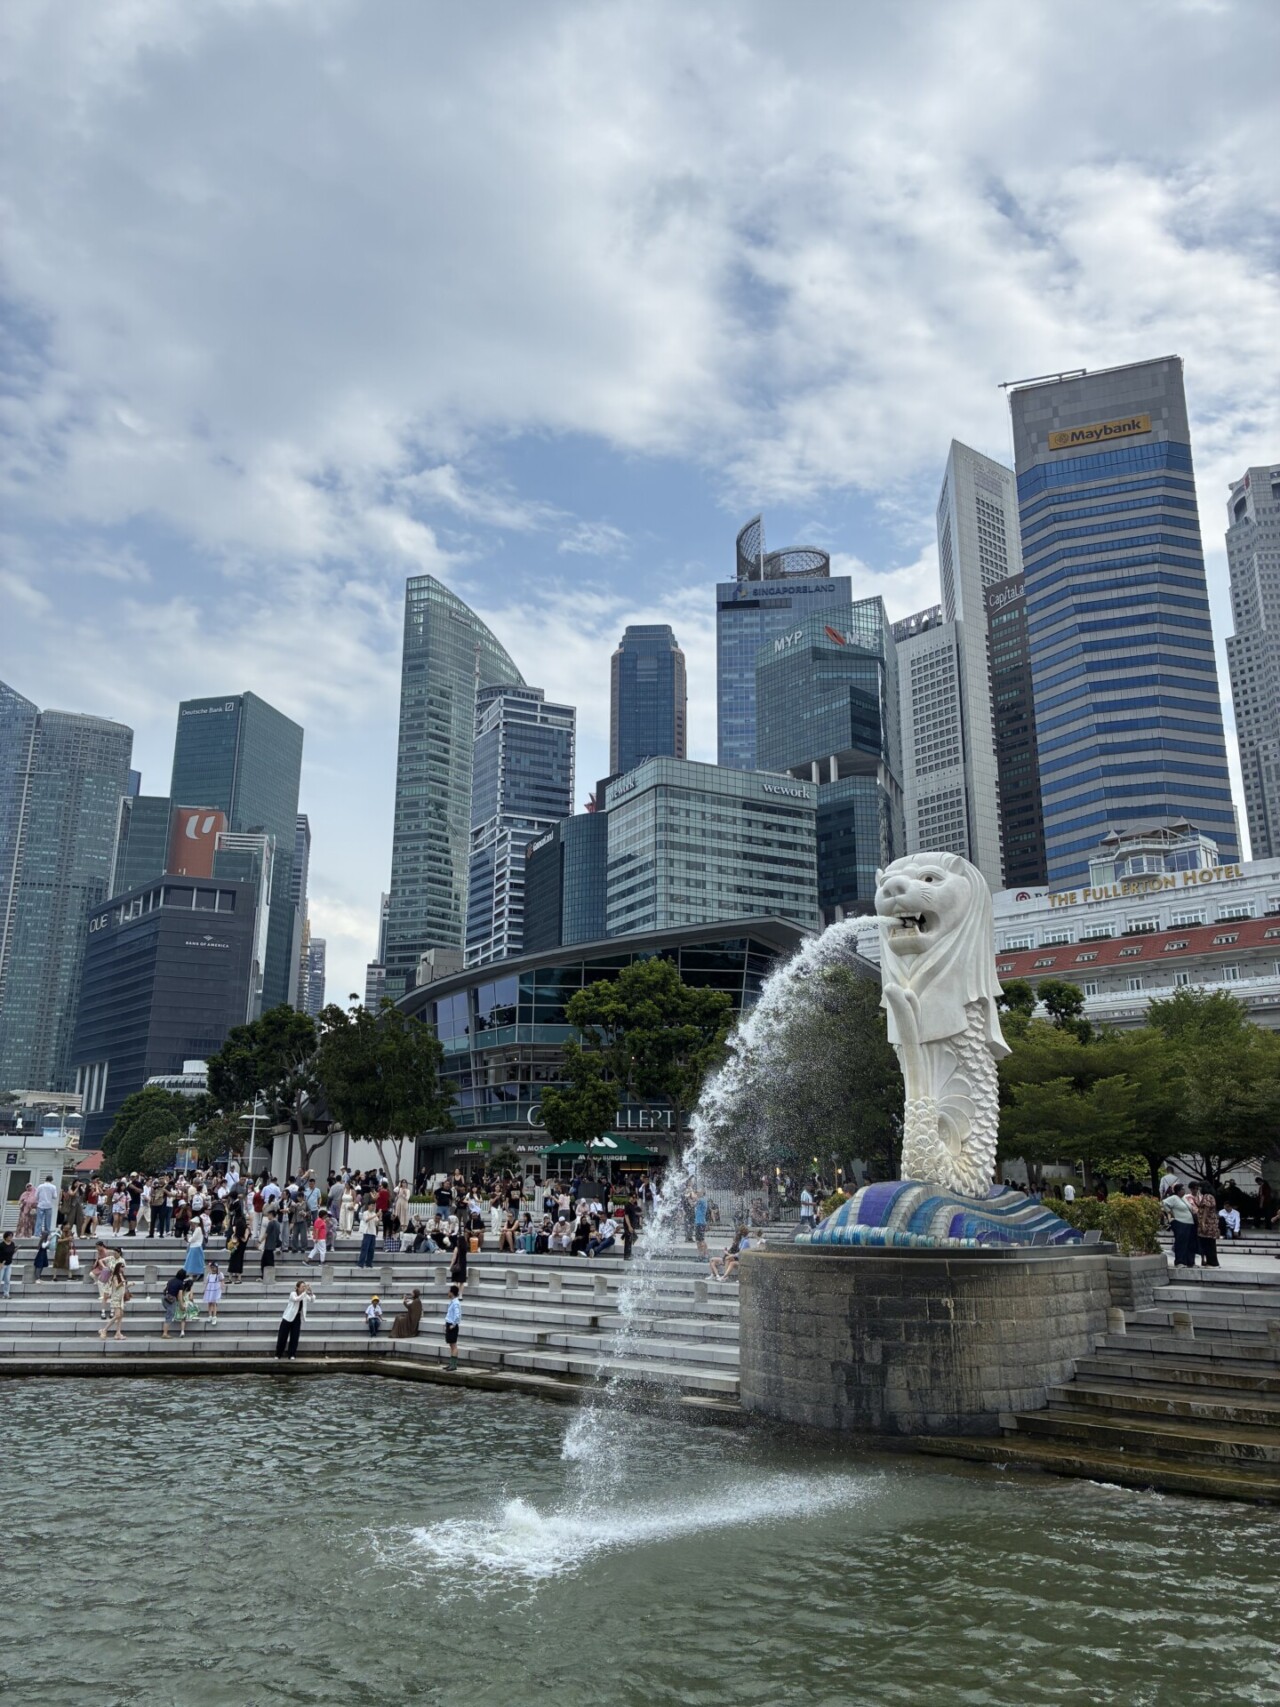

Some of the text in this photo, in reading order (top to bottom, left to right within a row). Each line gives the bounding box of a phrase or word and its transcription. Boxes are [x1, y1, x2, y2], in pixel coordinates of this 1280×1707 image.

[1071, 420, 1141, 441] Maybank
[753, 584, 836, 597] SINGAPORELAND
[774, 631, 803, 653] MYP
[182, 708, 208, 716] Deutsche
[763, 783, 810, 799] wework
[1048, 864, 1244, 907] THE FULLERTON HOTEL
[90, 913, 109, 933] OUE
